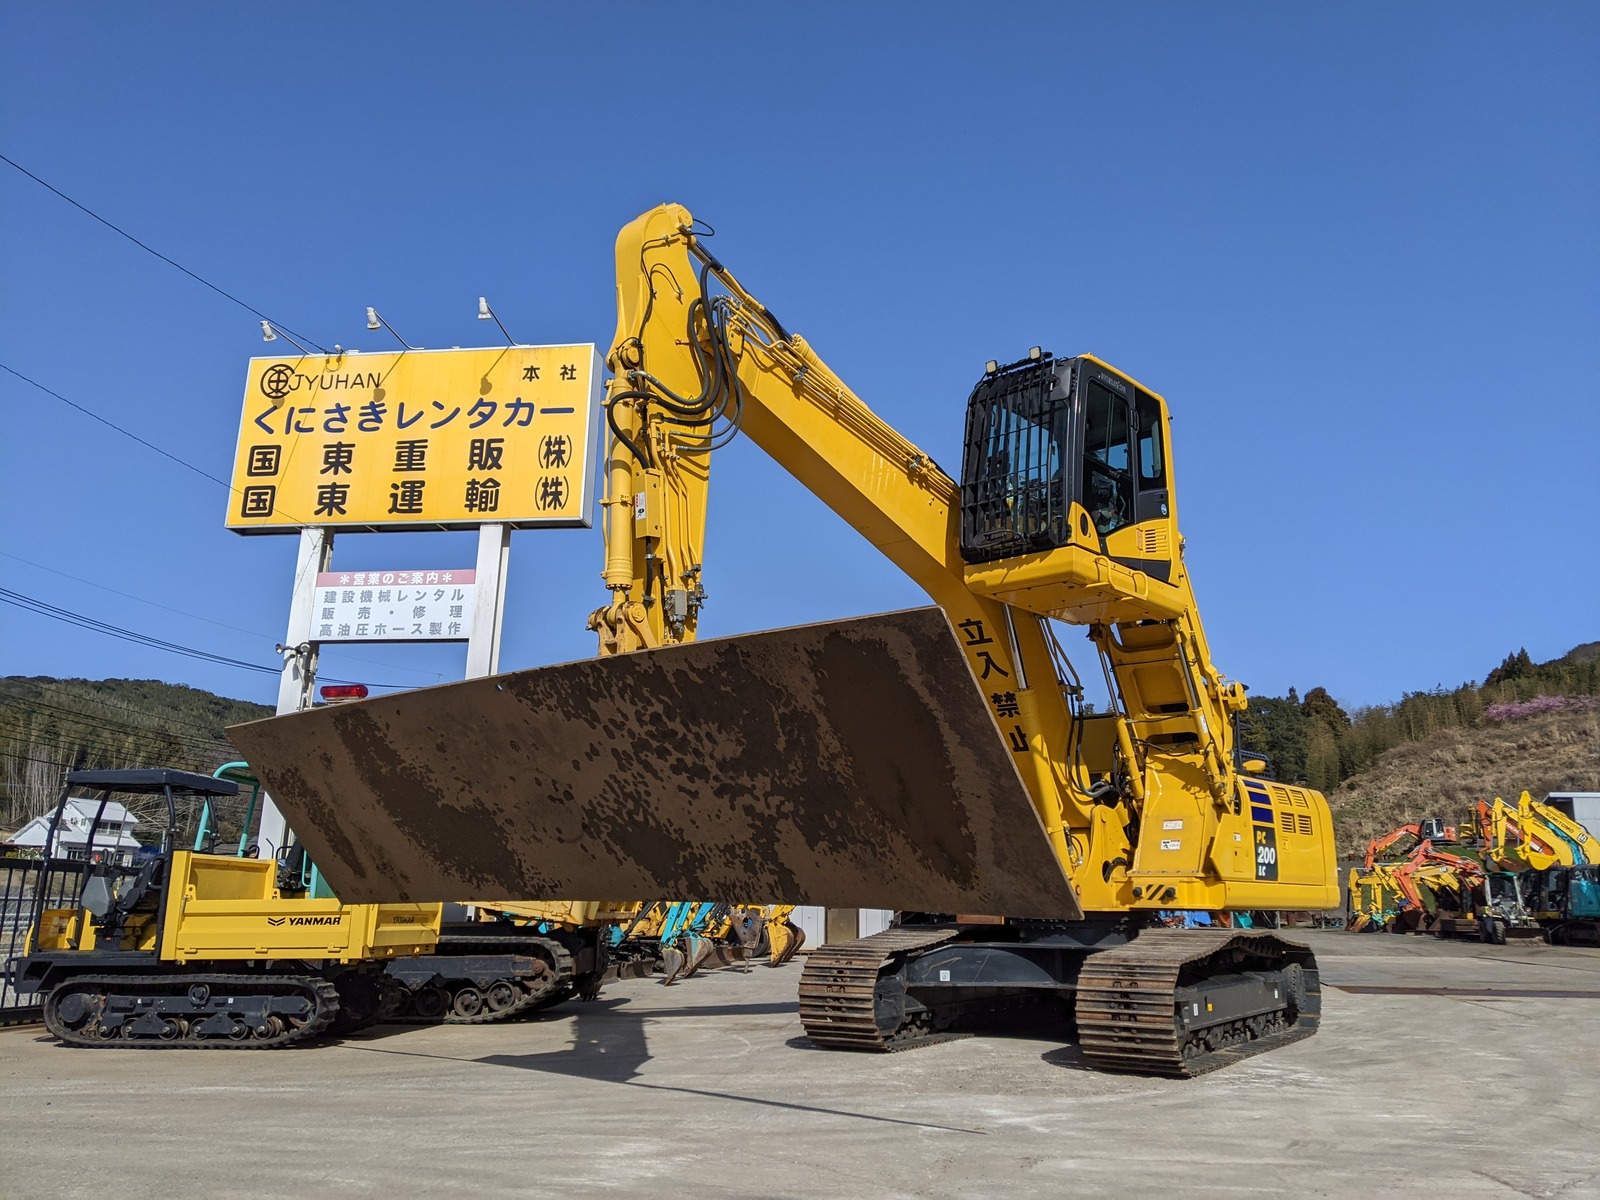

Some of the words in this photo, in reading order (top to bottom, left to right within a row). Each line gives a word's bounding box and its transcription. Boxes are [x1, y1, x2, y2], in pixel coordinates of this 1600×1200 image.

[288, 372, 381, 391] JYUHAN
[521, 364, 577, 382] 本社
[254, 397, 576, 435] くにさきレンタカー
[323, 588, 465, 604] 建設機械レンタル
[319, 621, 462, 637] 高油圧ホース製作
[957, 618, 1030, 753] 立入禁止
[1256, 830, 1267, 845] PC
[1257, 845, 1276, 865] 200
[289, 916, 341, 926] YANMAR
